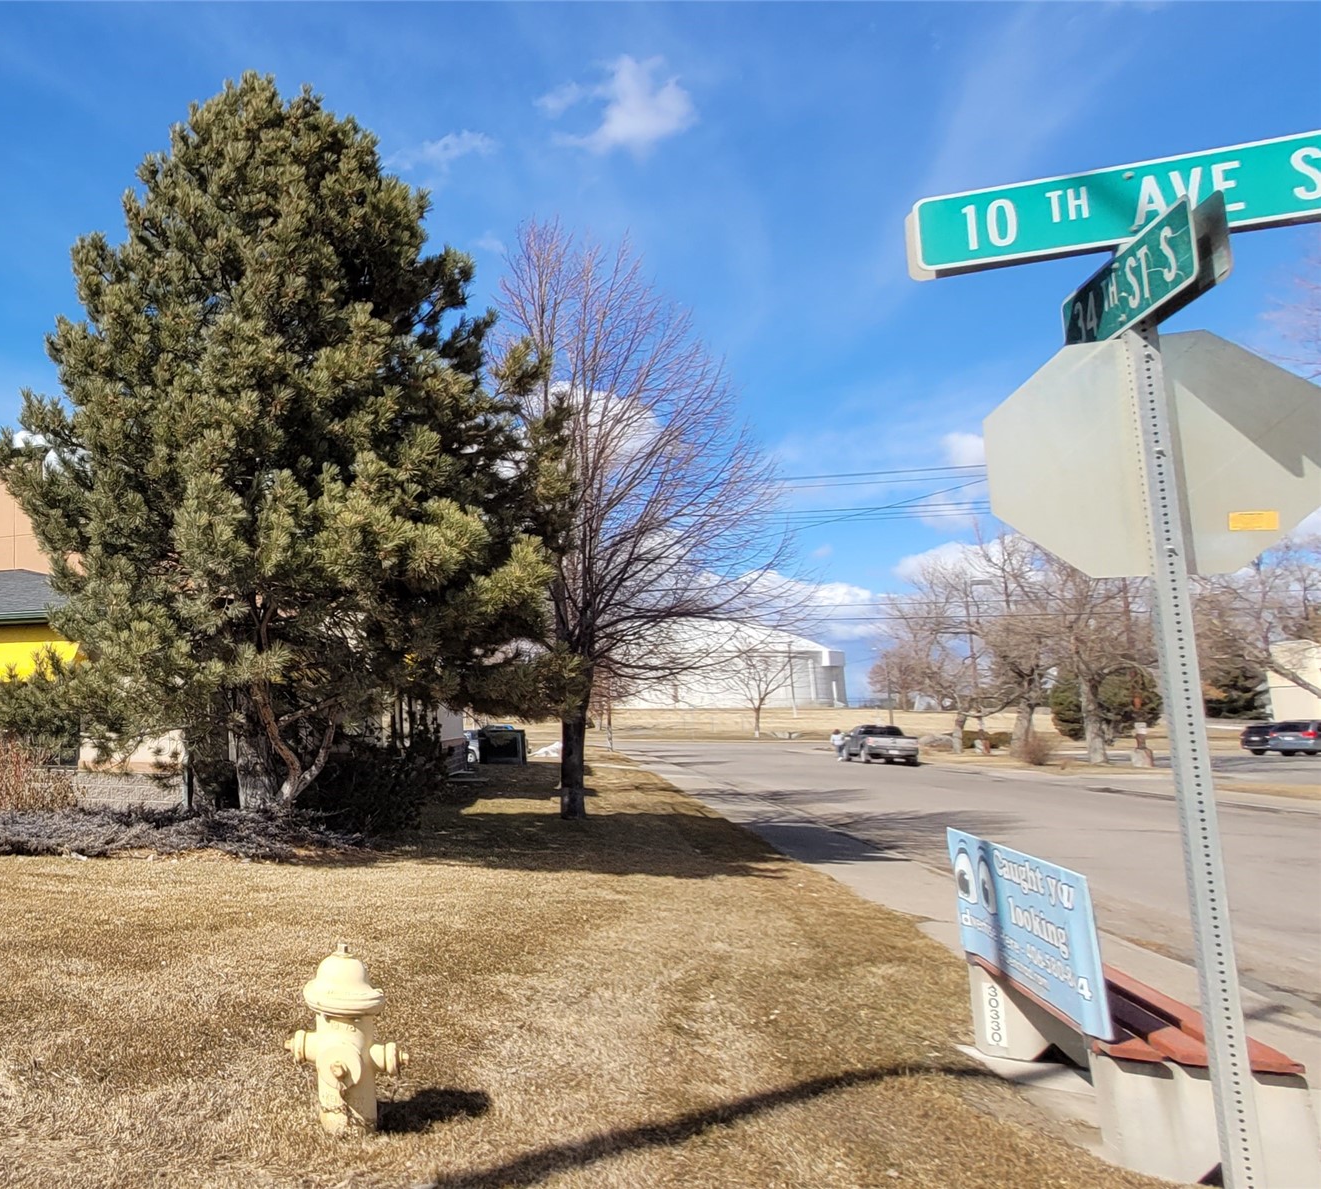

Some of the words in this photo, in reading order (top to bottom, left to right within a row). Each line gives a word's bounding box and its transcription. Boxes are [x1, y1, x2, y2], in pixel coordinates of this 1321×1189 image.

[961, 198, 1018, 251] 10
[1045, 186, 1090, 223] TH
[1134, 160, 1246, 227] AVE
[1289, 147, 1321, 200] S
[1074, 290, 1098, 344] 34
[1100, 271, 1119, 312] TH
[1124, 244, 1152, 309] ST
[1159, 226, 1177, 282] S
[993, 848, 1046, 896] Caught
[1007, 896, 1069, 960] looking
[988, 985, 1002, 1043] 30330
